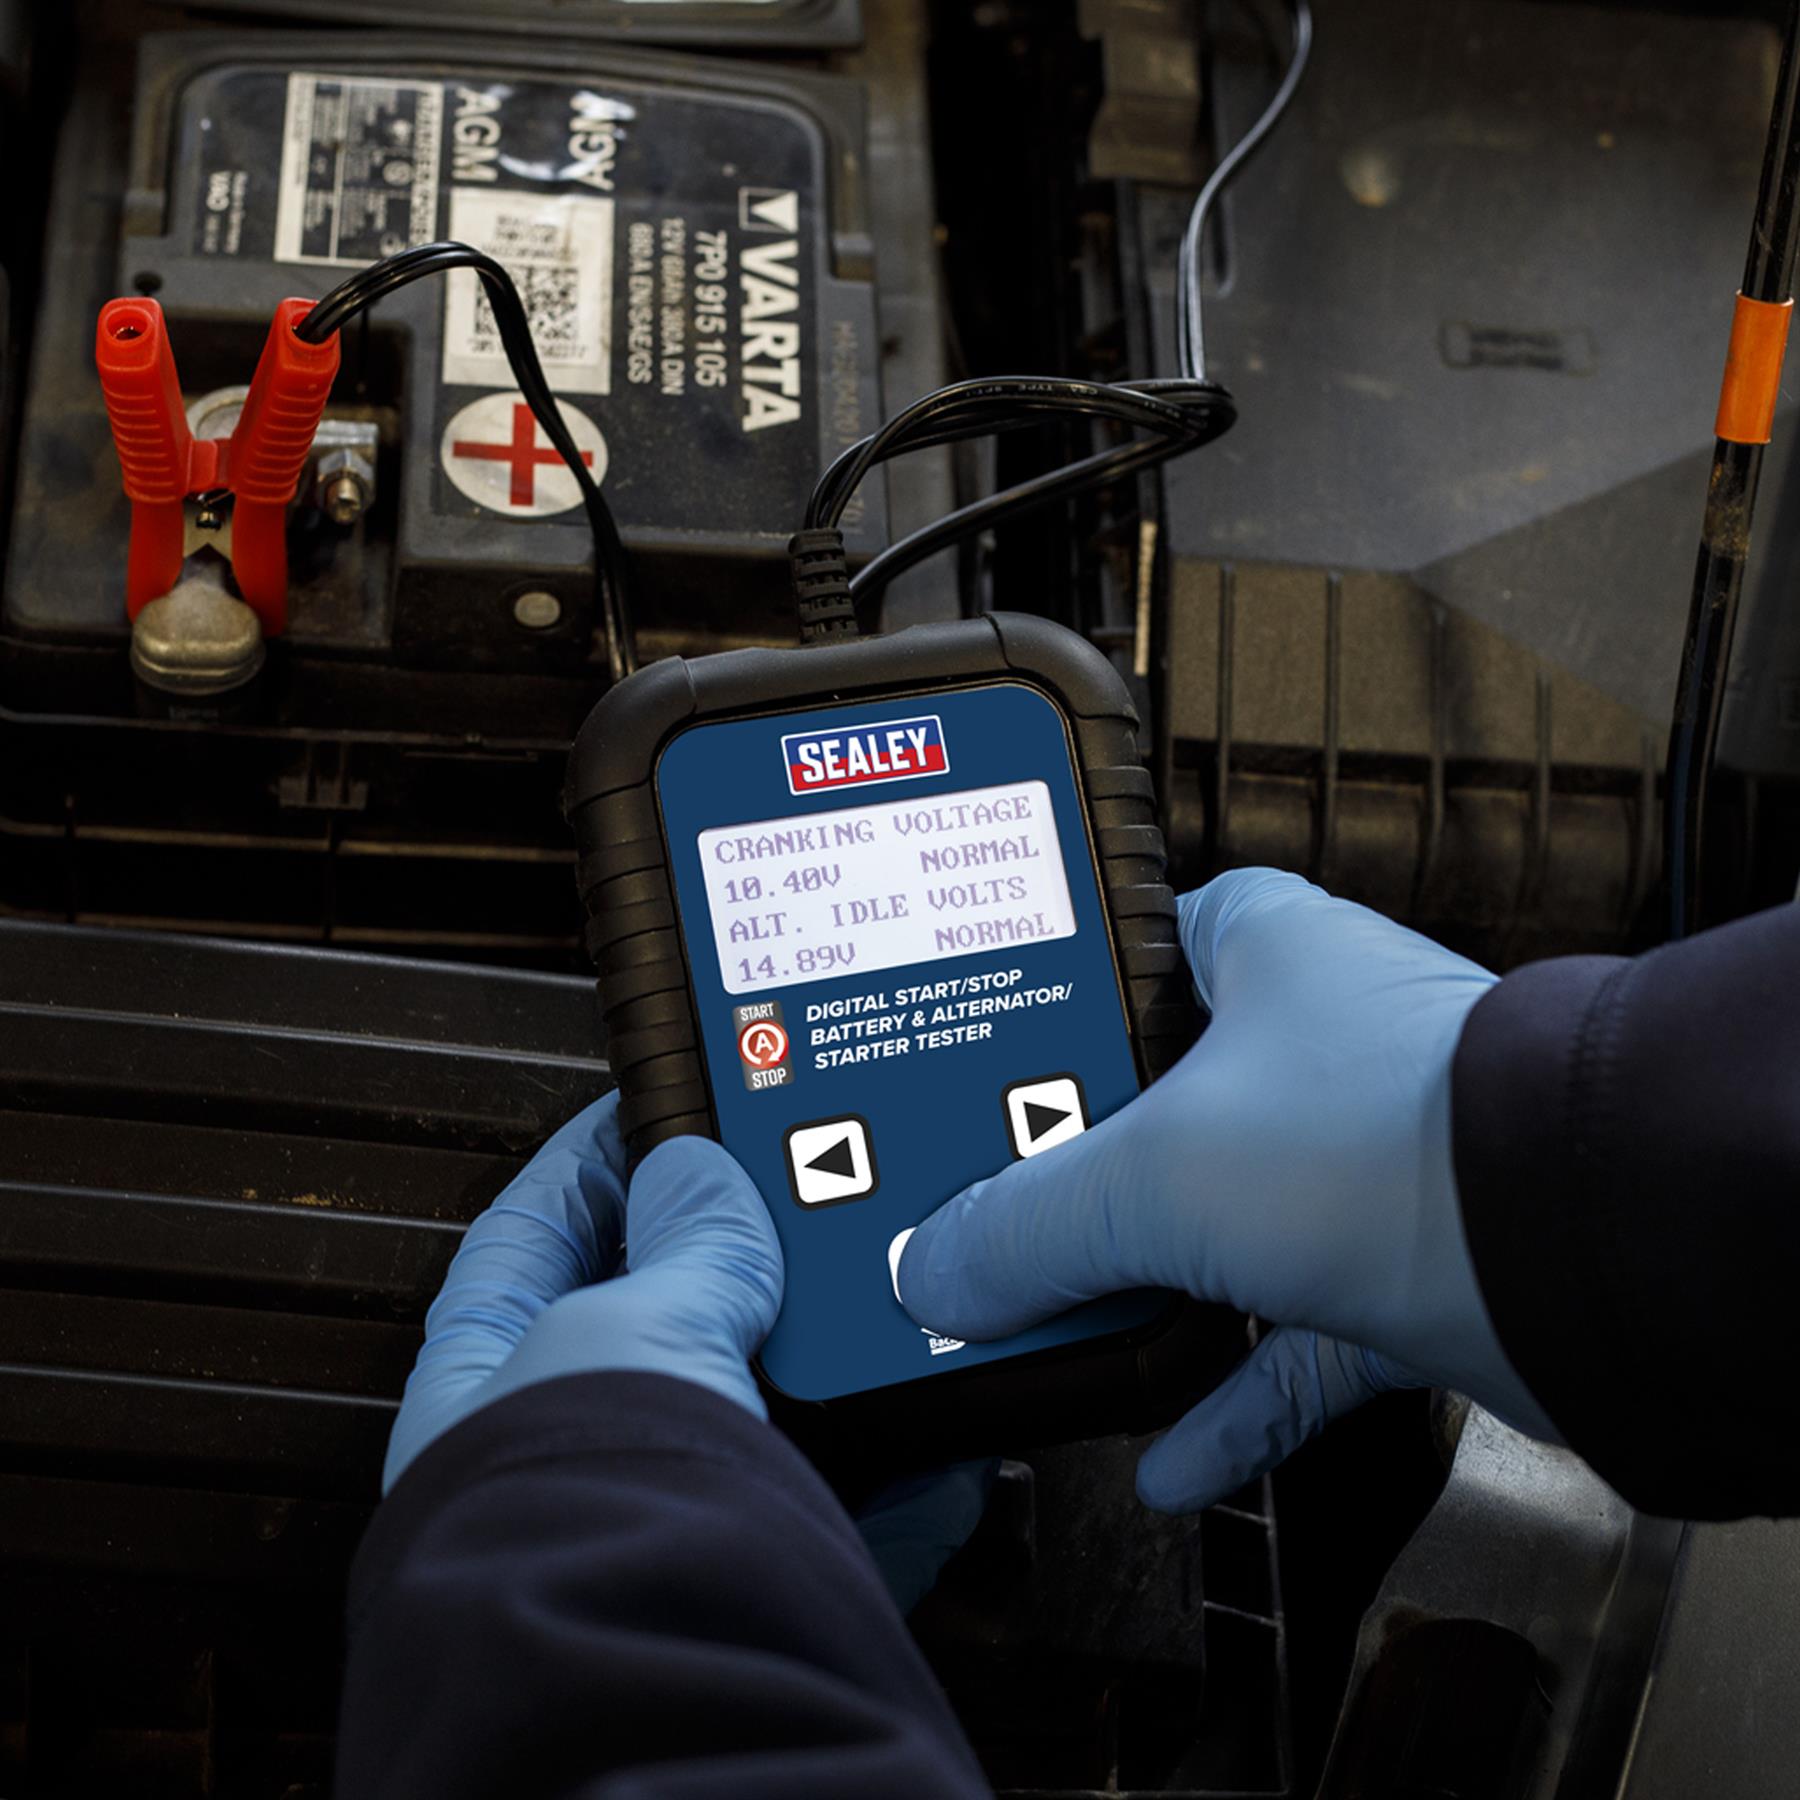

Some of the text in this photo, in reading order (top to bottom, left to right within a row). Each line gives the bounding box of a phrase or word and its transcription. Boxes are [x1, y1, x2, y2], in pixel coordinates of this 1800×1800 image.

[452, 84, 500, 181] AGM
[694, 284, 728, 332] 915
[740, 239, 801, 432] VARTA
[660, 358, 687, 395] DIN
[694, 340, 728, 389] 105
[798, 727, 927, 783] SEALEY
[714, 796, 1032, 864] CRANKING VOLTAGE
[724, 835, 1040, 904] 10.40V NORMAL
[729, 876, 1027, 943] ALT. IDLE VOLTS
[738, 912, 1054, 983] 14.89V NORMAL
[740, 1003, 774, 1022] START
[806, 969, 1023, 1023] DIGITAL START/STOP
[811, 983, 1072, 1046] BATTERY & ALTERNATOR/
[755, 1032, 774, 1054] A
[815, 1022, 993, 1069] STARTER TESTER
[752, 1067, 787, 1089] STOP
